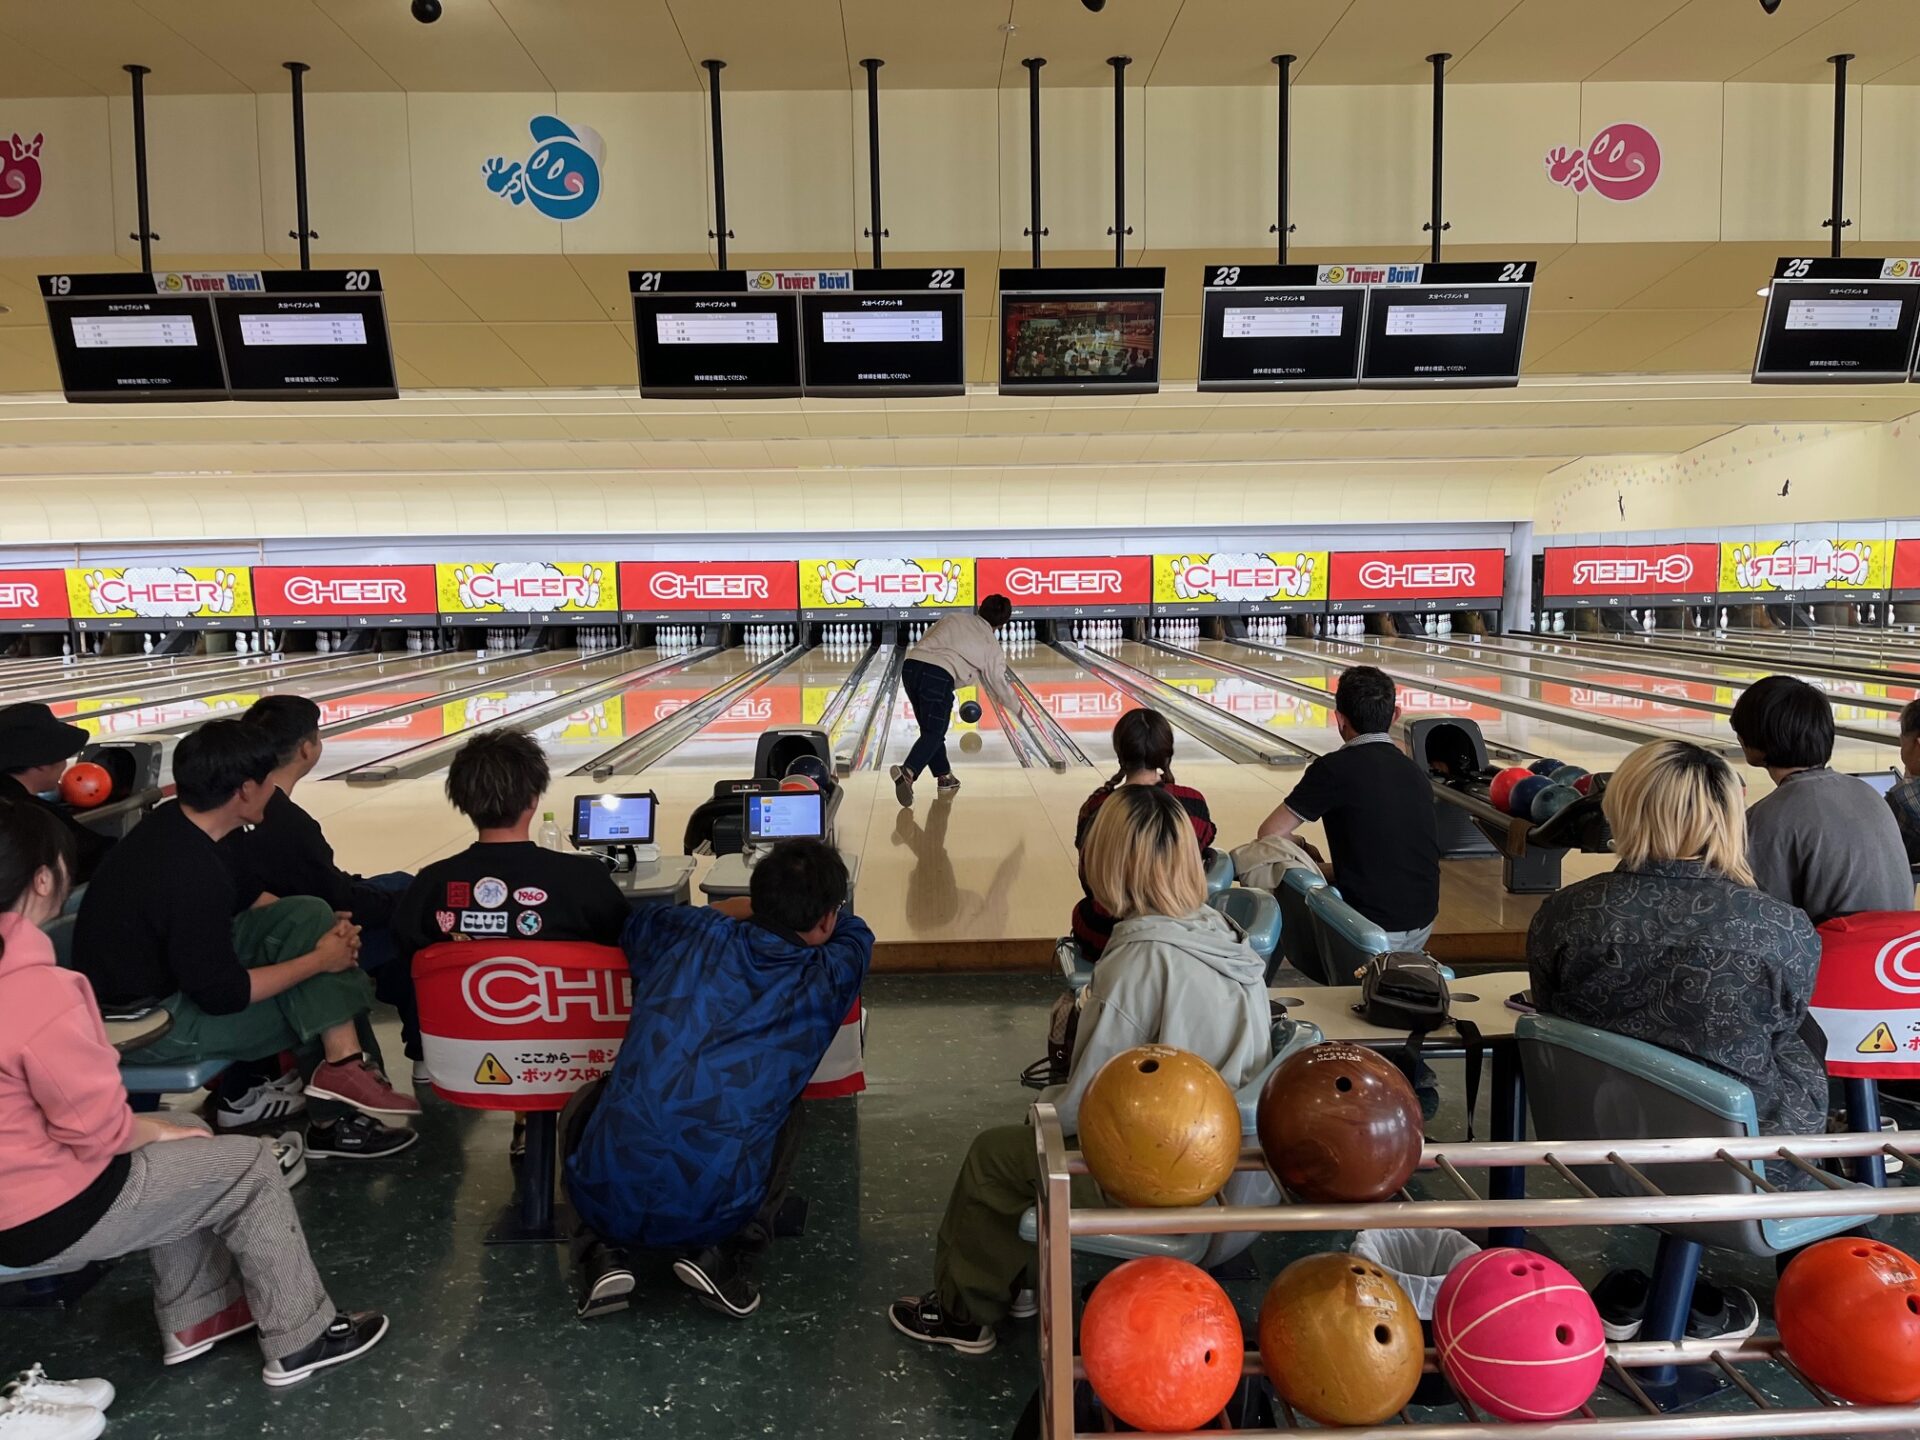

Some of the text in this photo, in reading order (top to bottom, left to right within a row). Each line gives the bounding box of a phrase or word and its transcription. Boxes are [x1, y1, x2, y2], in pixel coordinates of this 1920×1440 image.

[1212, 267, 1240, 286] 23
[1346, 266, 1419, 283] Tower Bowl
[1497, 263, 1527, 282] 24
[1783, 259, 1813, 277] 25
[49, 275, 72, 295] 19
[182, 273, 261, 291] Tower Bowl
[345, 271, 370, 291] 20
[639, 272, 662, 291] 21
[775, 272, 850, 289] Tower Bowl
[928, 270, 955, 289] 22
[831, 571, 943, 594] CHEER
[1006, 568, 1122, 595] CHEER
[1184, 565, 1297, 588] CHEER
[1359, 561, 1475, 588] CHEER
[99, 580, 221, 604] CHEER
[284, 577, 406, 604] CHEER
[469, 575, 585, 598] CHEER
[649, 571, 768, 599] CHEER
[1074, 607, 1084, 615] 24
[1157, 605, 1167, 614] 25
[1250, 604, 1260, 612] 26
[1333, 602, 1343, 611] 27
[1427, 601, 1437, 609] 28
[262, 618, 271, 627] 15
[359, 617, 368, 625] 16
[445, 615, 453, 624] 17
[541, 614, 550, 622] 18
[626, 613, 634, 621] 19
[721, 612, 732, 620] 20
[805, 611, 815, 620] 21
[899, 610, 909, 618] 22
[78, 621, 88, 629] 13
[175, 620, 186, 628] 14
[517, 890, 546, 902] 1960
[463, 914, 507, 929] CLUB
